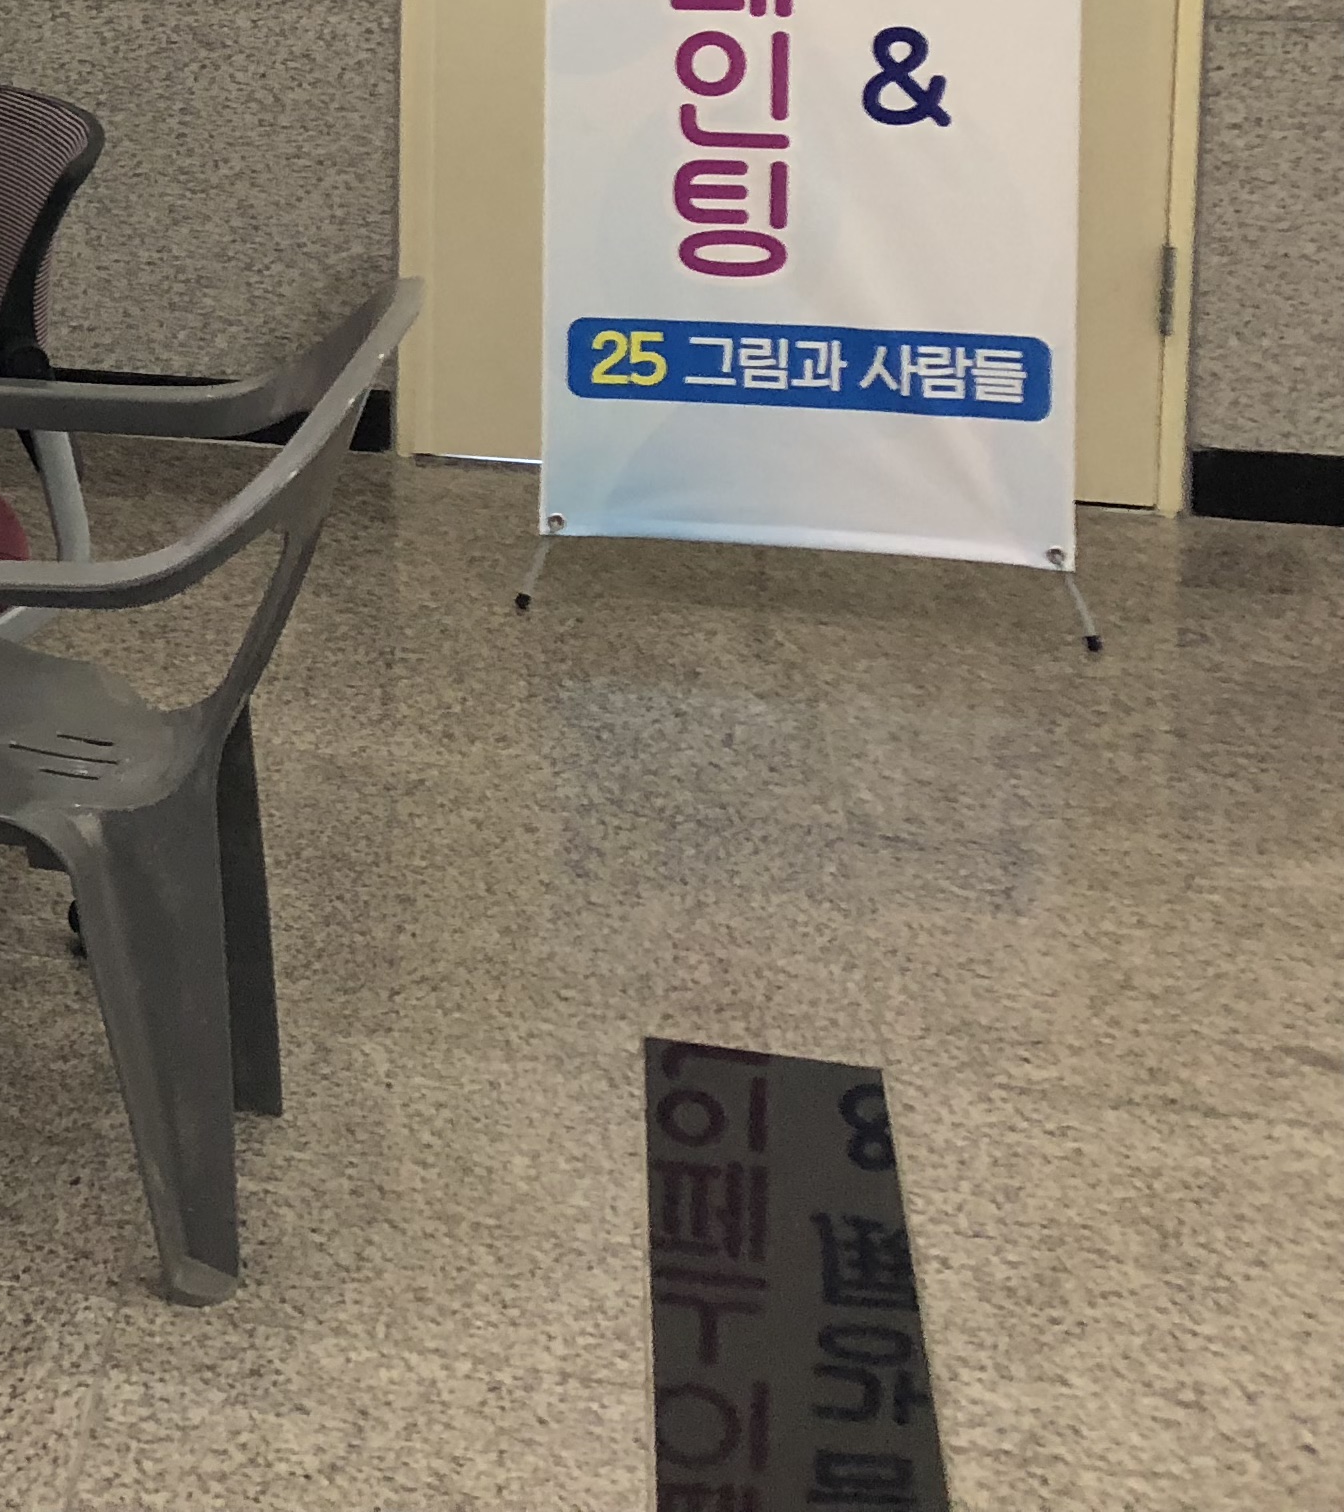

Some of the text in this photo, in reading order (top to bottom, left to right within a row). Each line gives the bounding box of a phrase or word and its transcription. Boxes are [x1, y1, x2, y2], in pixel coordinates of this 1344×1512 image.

[860, 25, 952, 129] &
[590, 331, 1028, 403] 25 그림과 사람들
